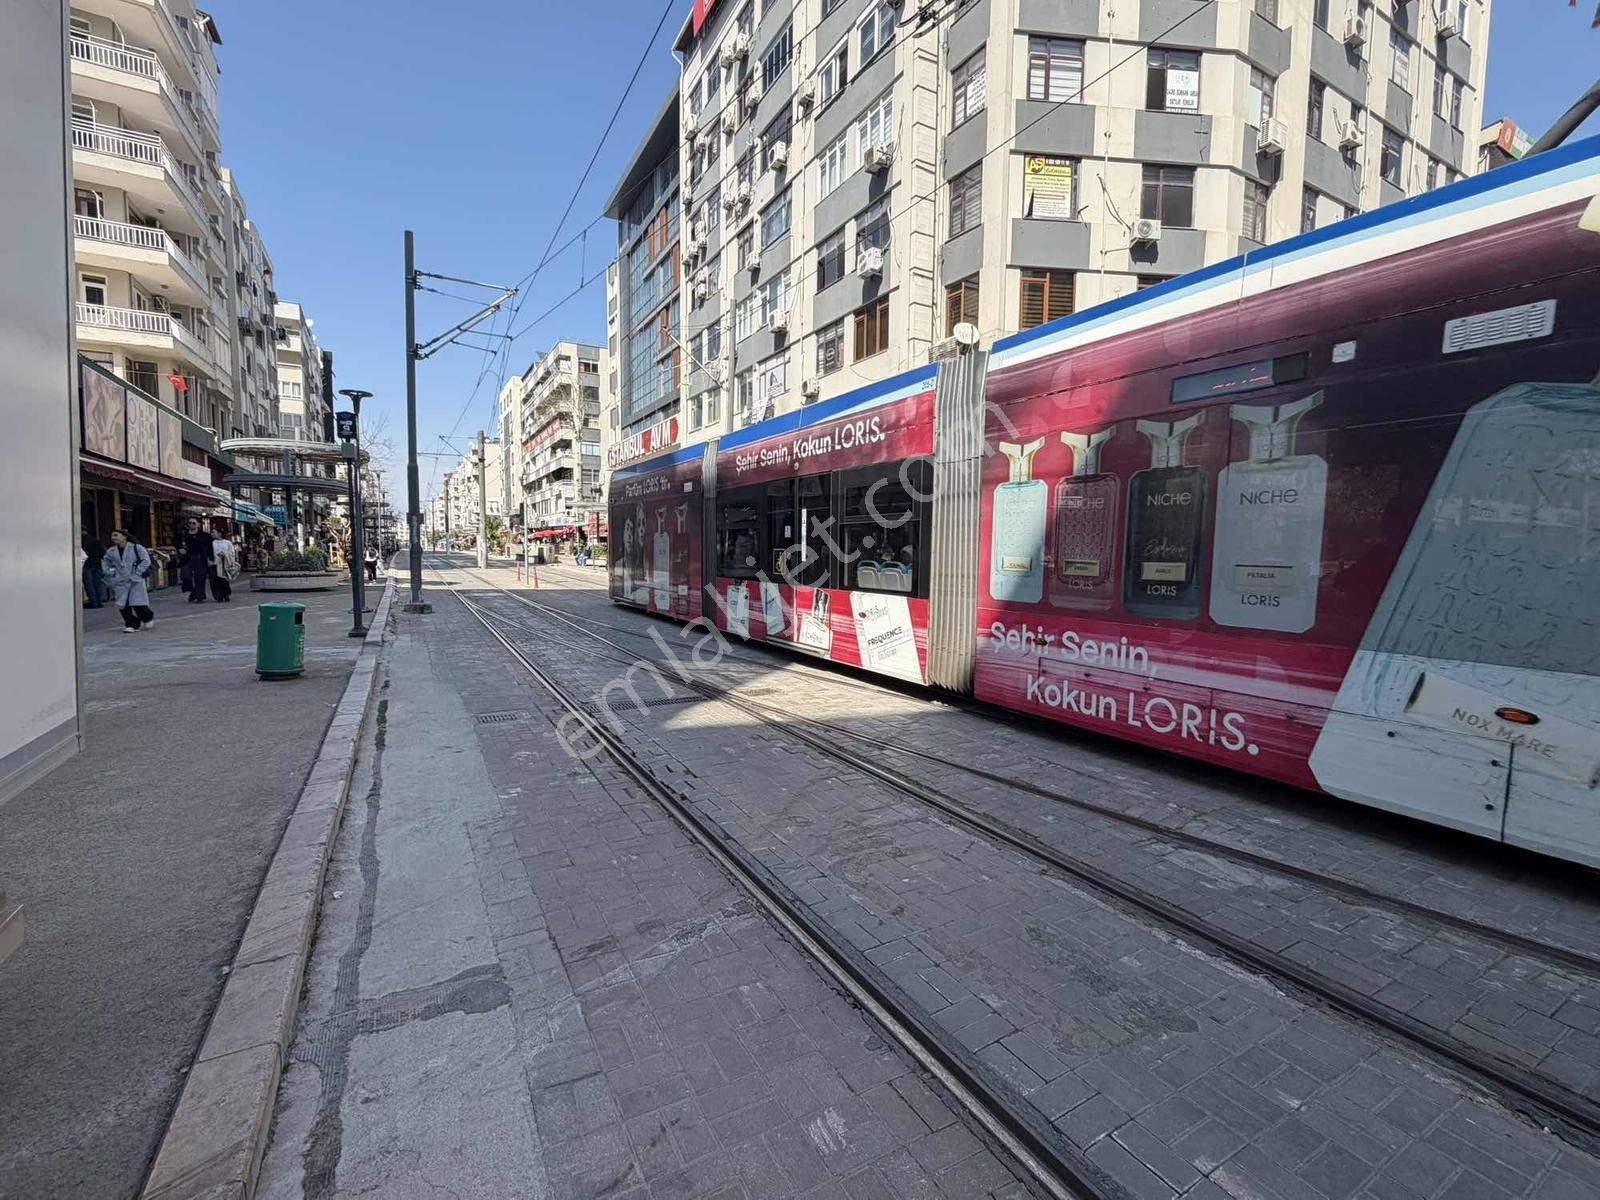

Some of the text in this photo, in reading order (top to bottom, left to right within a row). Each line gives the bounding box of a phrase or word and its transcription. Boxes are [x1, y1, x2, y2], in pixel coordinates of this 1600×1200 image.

[650, 420, 671, 452] AVM
[793, 435, 832, 460] Kokun
[1146, 584, 1178, 596] LORIS
[1241, 594, 1281, 608] LORIS
[867, 625, 903, 646] FREQUENCE
[991, 621, 1159, 682] Şehir Senin,
[1026, 674, 1260, 756] Kokun LORIS.
[1452, 707, 1558, 758] NOX MARE
